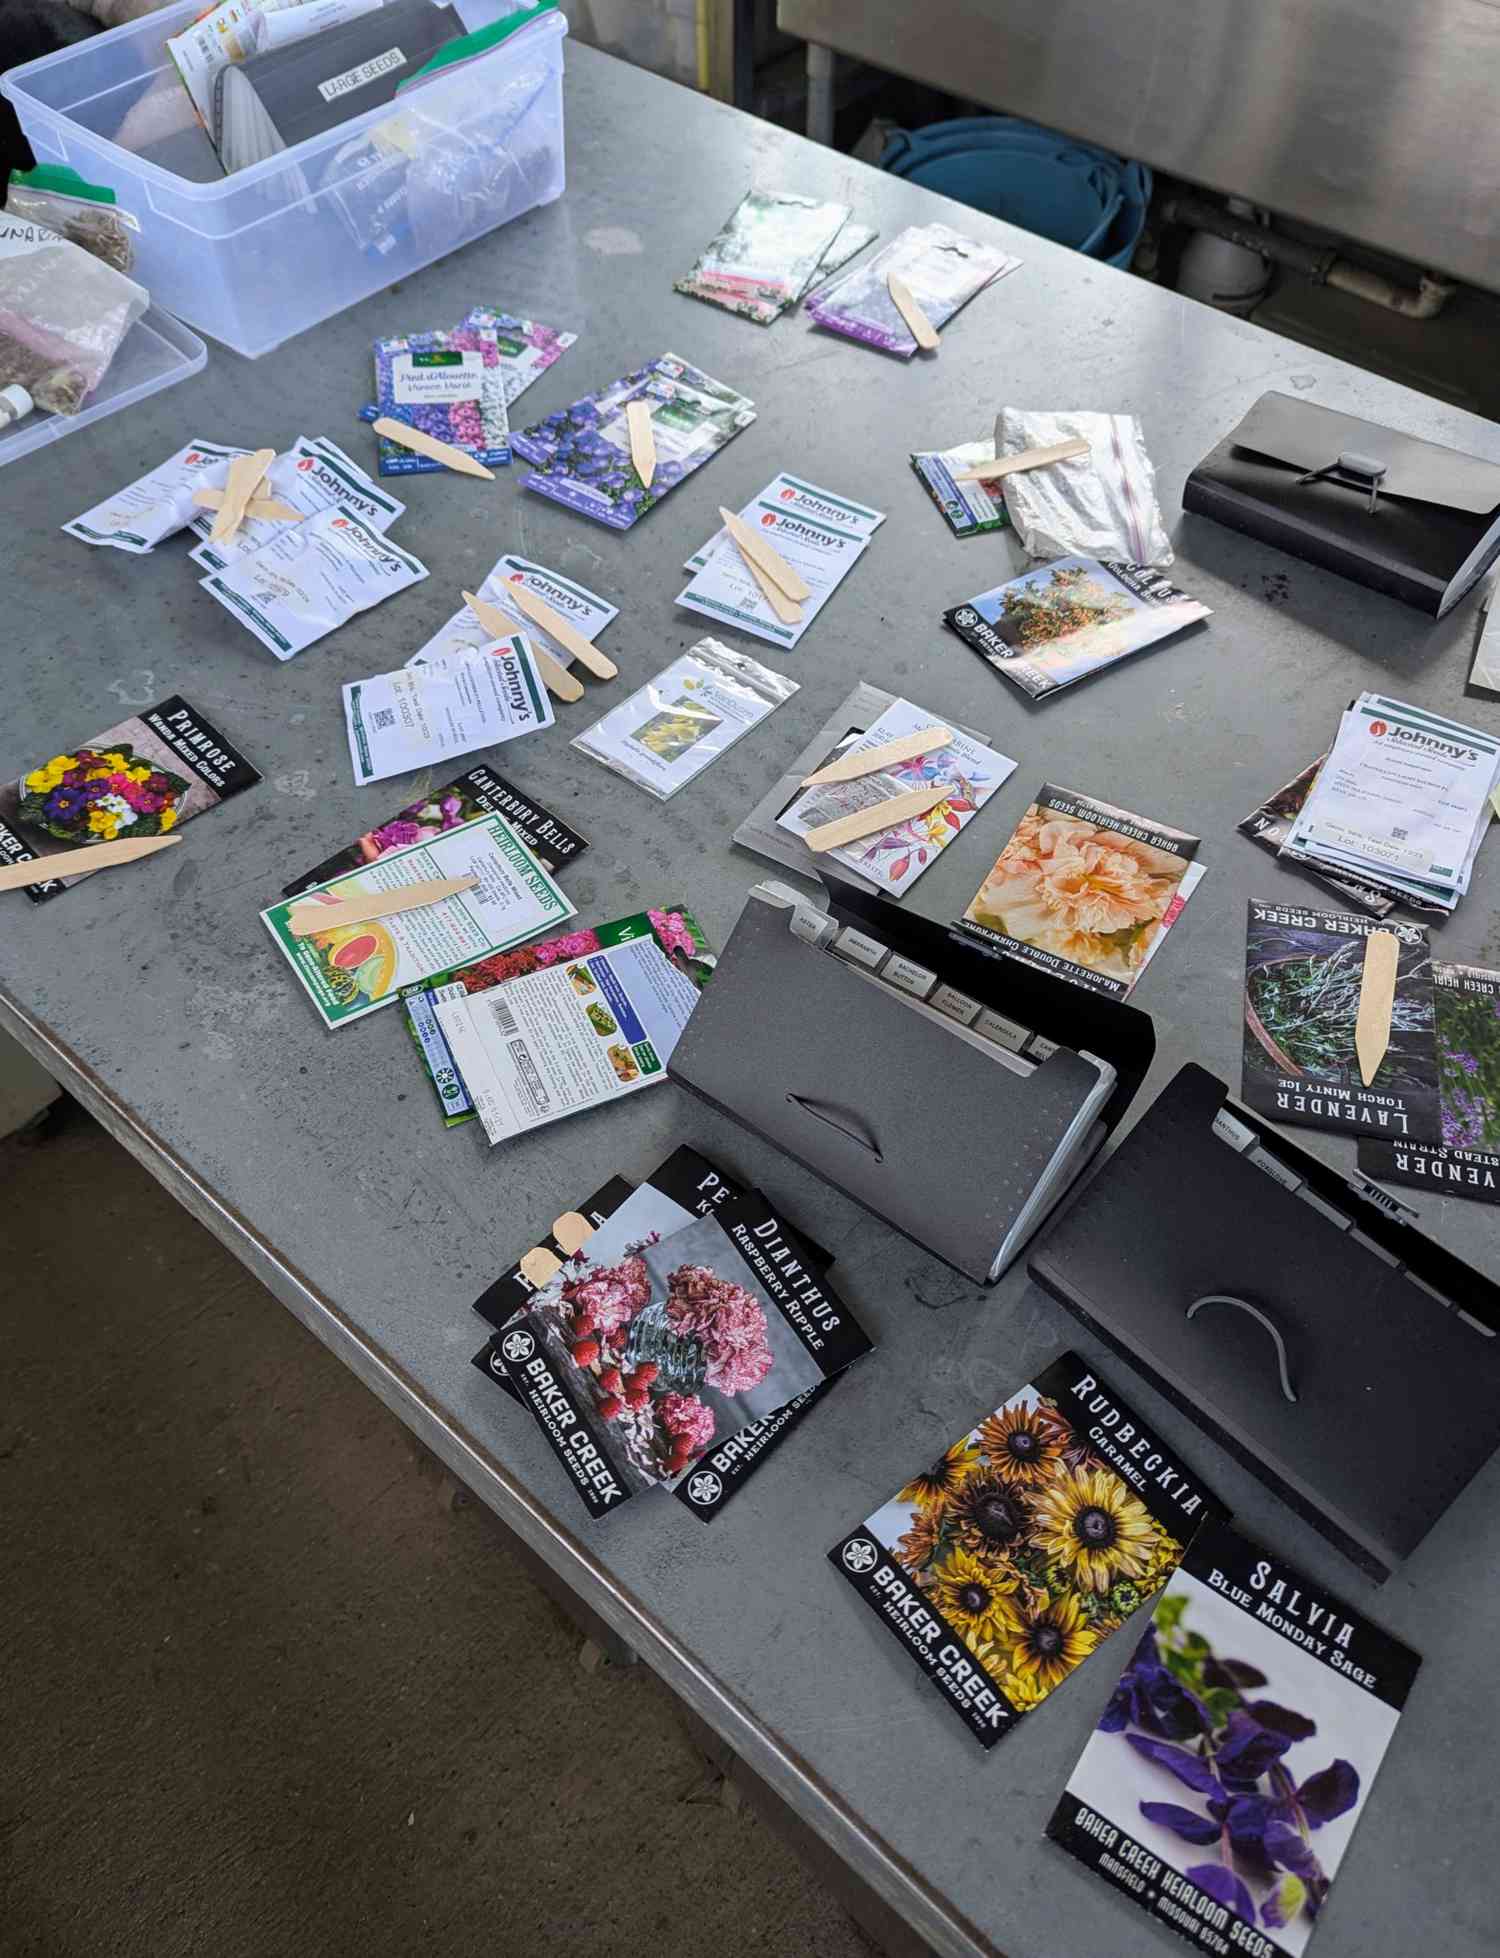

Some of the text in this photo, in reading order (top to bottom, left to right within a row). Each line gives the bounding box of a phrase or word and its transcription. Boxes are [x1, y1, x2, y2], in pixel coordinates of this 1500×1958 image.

[324, 51, 400, 96] LARGE SEEDS
[311, 466, 379, 518] Johnny's
[795, 494, 859, 524] Johnny's
[347, 526, 403, 574] Johnny's
[776, 516, 846, 549] Johnny's
[527, 575, 594, 617] Johnny's
[974, 623, 1014, 659] BAKER
[500, 654, 531, 723] Johnny's
[147, 713, 228, 788] WANDA MIXED COLORS
[167, 709, 236, 773] PRIMROSE
[1389, 724, 1480, 762] Johnny's
[469, 769, 576, 855] CANTERBURY BELLS
[1048, 799, 1076, 816] SEEDS
[1078, 809, 1120, 833] HEIRLOOM
[511, 821, 539, 847] MIXED
[1121, 826, 1149, 843] CREEK
[1150, 836, 1179, 852] BAKER
[488, 824, 559, 911] HEIRLOOM SEEDS
[1253, 908, 1392, 936] AKER CREEK
[1022, 946, 1061, 968] DOUBLE
[1063, 962, 1120, 992] MAJORETTE
[1463, 980, 1494, 994] CREEK
[1276, 1092, 1408, 1134] LAVENDER
[1278, 1079, 1406, 1110] TORCH MINTY ICE
[1393, 1139, 1500, 1167] STEAD STRAIN
[1396, 1153, 1496, 1190] VENDER
[732, 1223, 825, 1350] RASPBERRY RIPPLE
[753, 1218, 840, 1332] DIANTHUS
[525, 1359, 622, 1505] BAKER CREEK
[527, 1390, 568, 1450] HEIRLOOM
[562, 1446, 589, 1486] SEEDS
[743, 1409, 793, 1462] HEIRLOOM
[791, 1383, 817, 1410] SEED
[1070, 1374, 1203, 1516] RUDBECKIA
[1088, 1425, 1147, 1493] CARAMEL
[1250, 1560, 1353, 1648] SALVIA
[873, 1565, 1010, 1729] BAKER CREEK
[1207, 1568, 1377, 1689] BLUE MONDAY SAGE
[882, 1601, 939, 1667] HEIRLOOM
[935, 1667, 972, 1709] SEEDS
[1074, 1807, 1274, 1958] BAKER CREEK HEIRLOOM SEEDS
[1099, 1852, 1230, 1957] MANSFIELD MISSOURI 65704
